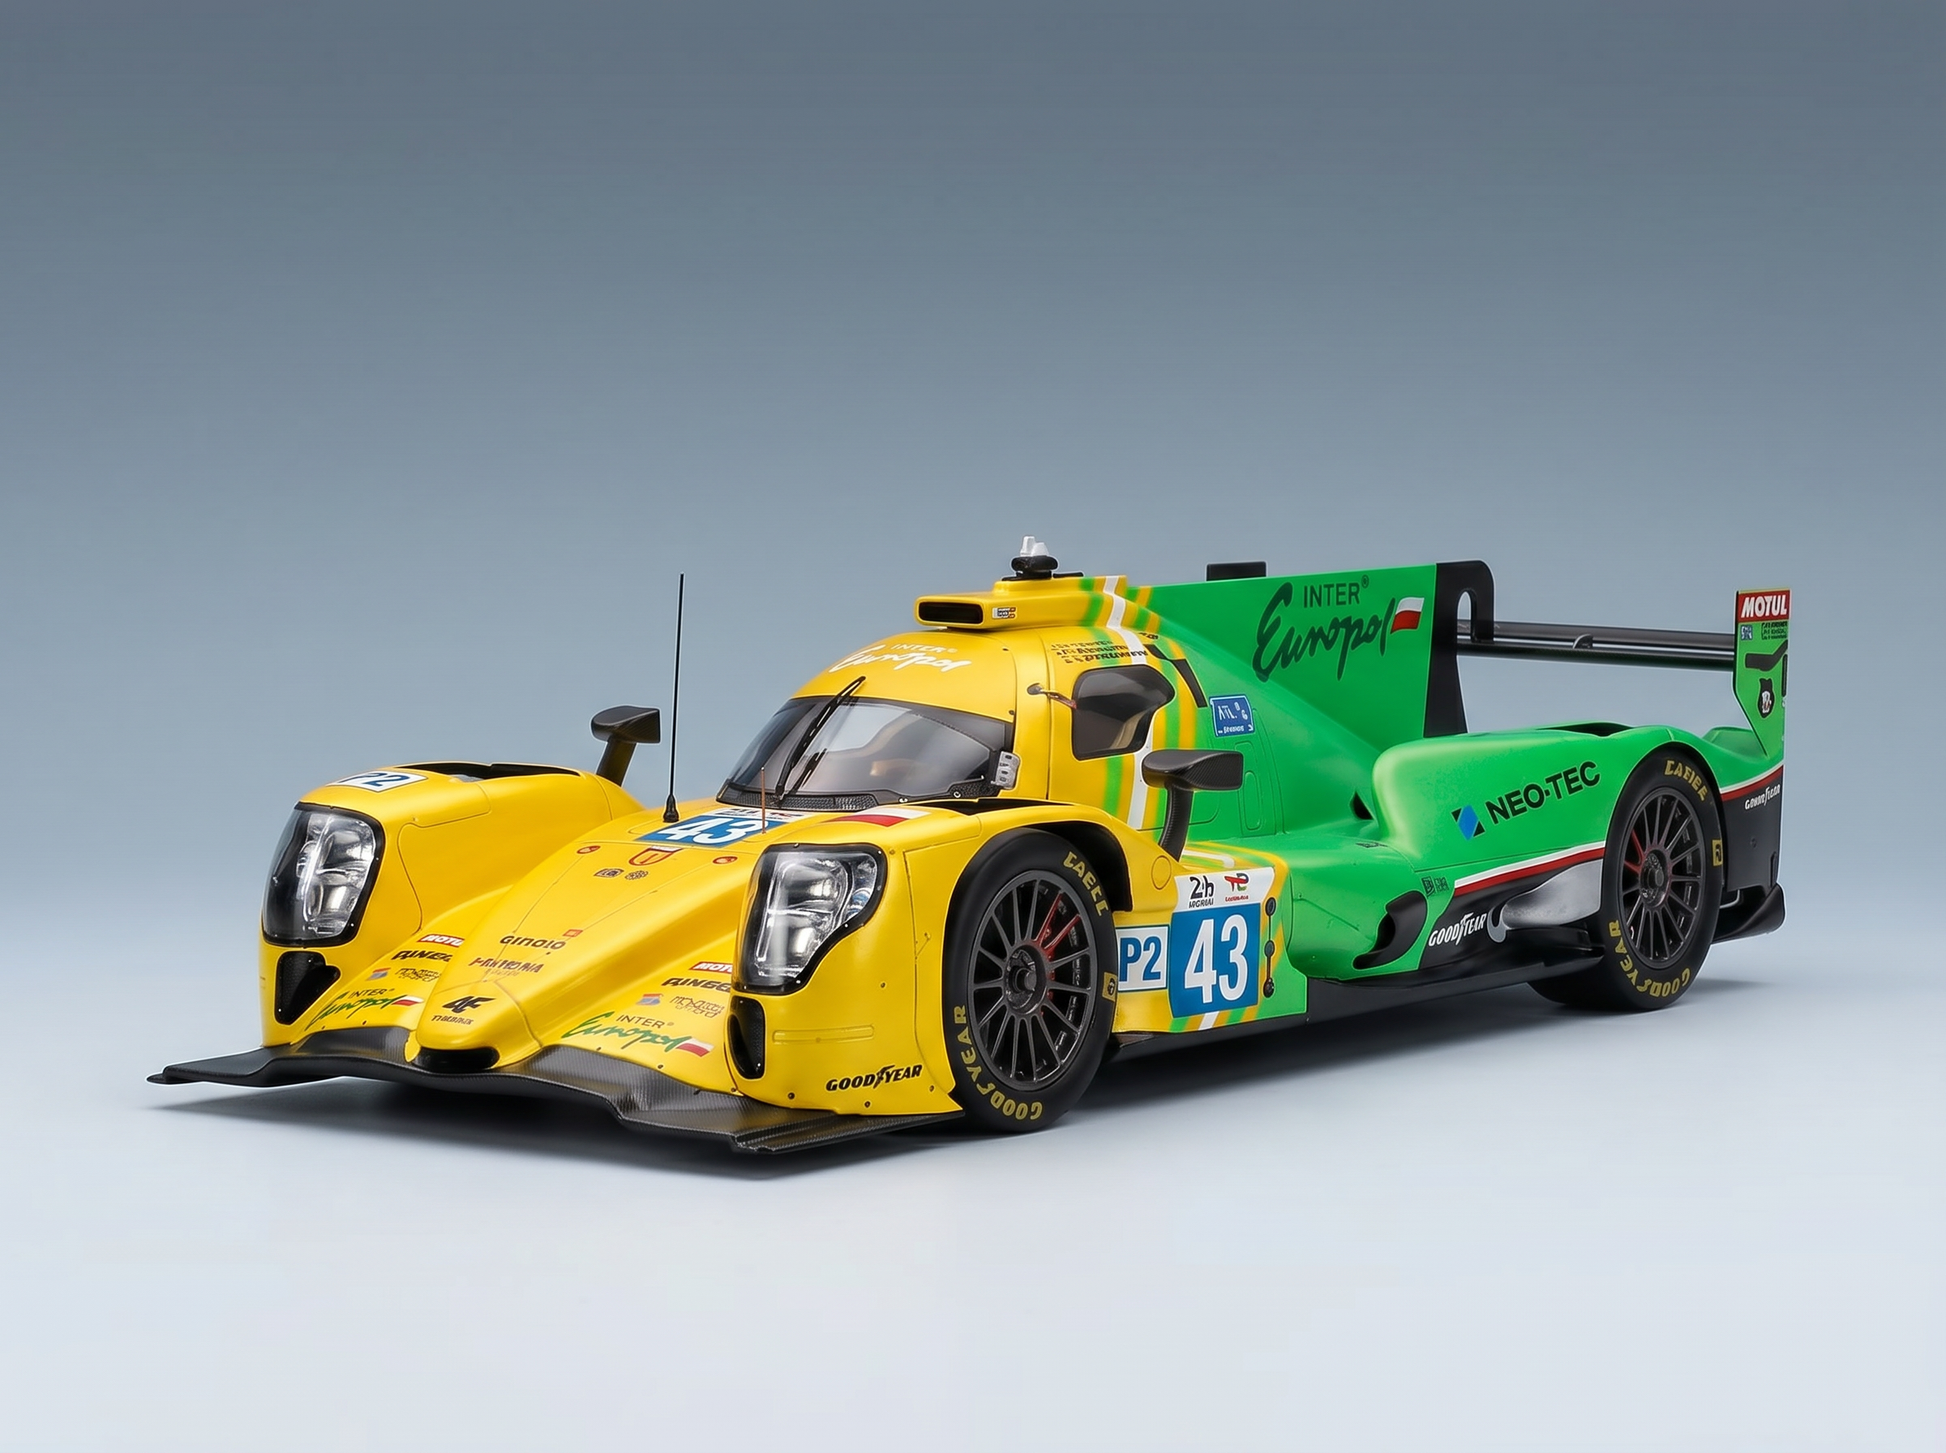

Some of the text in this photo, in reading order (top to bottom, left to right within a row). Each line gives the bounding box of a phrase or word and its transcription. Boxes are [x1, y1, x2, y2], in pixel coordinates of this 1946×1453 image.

[1741, 595, 1788, 618] MOTUL
[1252, 582, 1396, 683] Europol
[656, 817, 769, 844] 43
[1428, 912, 1487, 947] GOODYEAR
[1120, 936, 1161, 981] P2
[1184, 914, 1248, 1004] 43
[1608, 920, 1691, 998] GOODYEAR
[826, 1065, 923, 1091] GOODYEAR
[954, 1005, 1043, 1120] GOODYEAR
